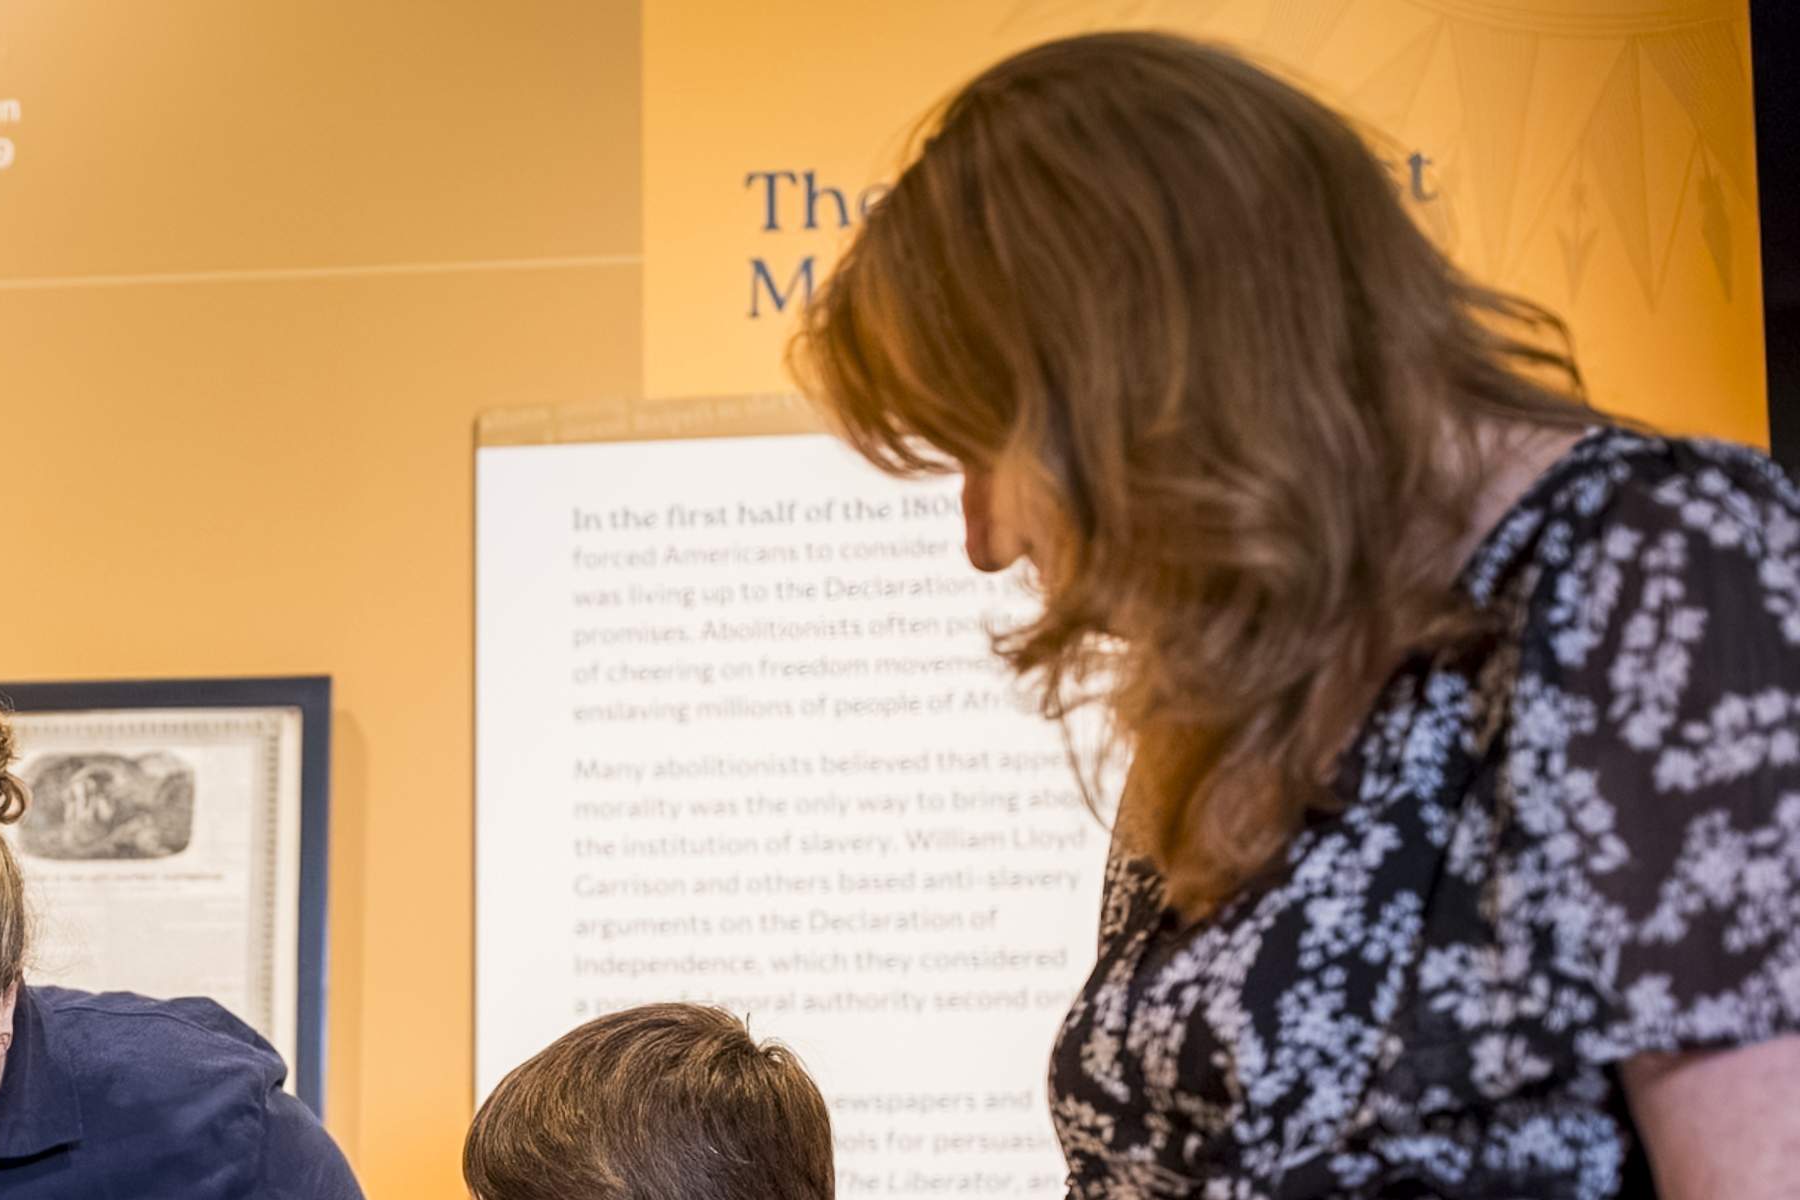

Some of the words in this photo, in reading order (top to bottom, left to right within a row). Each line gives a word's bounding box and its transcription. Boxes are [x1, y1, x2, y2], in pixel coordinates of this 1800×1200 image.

[572, 507, 603, 530] In
[607, 507, 658, 529] the
[664, 502, 728, 526] first
[735, 500, 797, 524] half
[802, 498, 836, 523] of
[840, 497, 893, 520] the
[572, 546, 657, 568] forced
[662, 545, 798, 565] Americans
[803, 542, 833, 561] to
[838, 539, 949, 560] consider
[572, 590, 622, 606] was
[626, 583, 696, 610] living
[701, 585, 734, 606] up
[739, 582, 768, 602] to
[774, 582, 817, 599] the
[572, 627, 689, 646] promises.
[699, 617, 863, 640] Abolitionists
[867, 615, 940, 635] often
[572, 661, 600, 683] of
[605, 663, 715, 685] cheering
[719, 661, 753, 680] on
[757, 657, 869, 677] freedom
[572, 703, 690, 724] enslaving
[695, 696, 794, 718] millions
[799, 695, 827, 714] of
[832, 695, 921, 717] people
[926, 692, 954, 712] of
[572, 759, 644, 781] Many
[652, 755, 813, 778] abolitionists
[818, 753, 930, 773] believed
[935, 751, 990, 771] that
[572, 798, 682, 820] morality
[687, 800, 739, 816] was
[743, 795, 789, 815] the
[793, 793, 850, 816] only
[855, 797, 909, 814] way
[914, 792, 945, 811] to
[949, 790, 1021, 814] bring
[572, 838, 616, 857] the
[620, 835, 759, 857] institution
[763, 831, 792, 854] of
[798, 834, 893, 854] slavery.
[903, 829, 1006, 850] William
[1010, 824, 1088, 850] Lloyd
[572, 874, 687, 897] Garrison
[690, 875, 741, 895] and
[744, 874, 832, 894] others
[835, 872, 917, 892] based
[920, 870, 1081, 891] anti-slavery
[572, 917, 713, 938] arguments
[717, 916, 753, 934] on
[757, 914, 802, 933] the
[806, 909, 964, 932] Declaration
[968, 909, 998, 929] of
[769, 952, 848, 972] which
[853, 951, 912, 972] they
[918, 949, 1069, 969] considered
[832, 1092, 978, 1114] ewspapers
